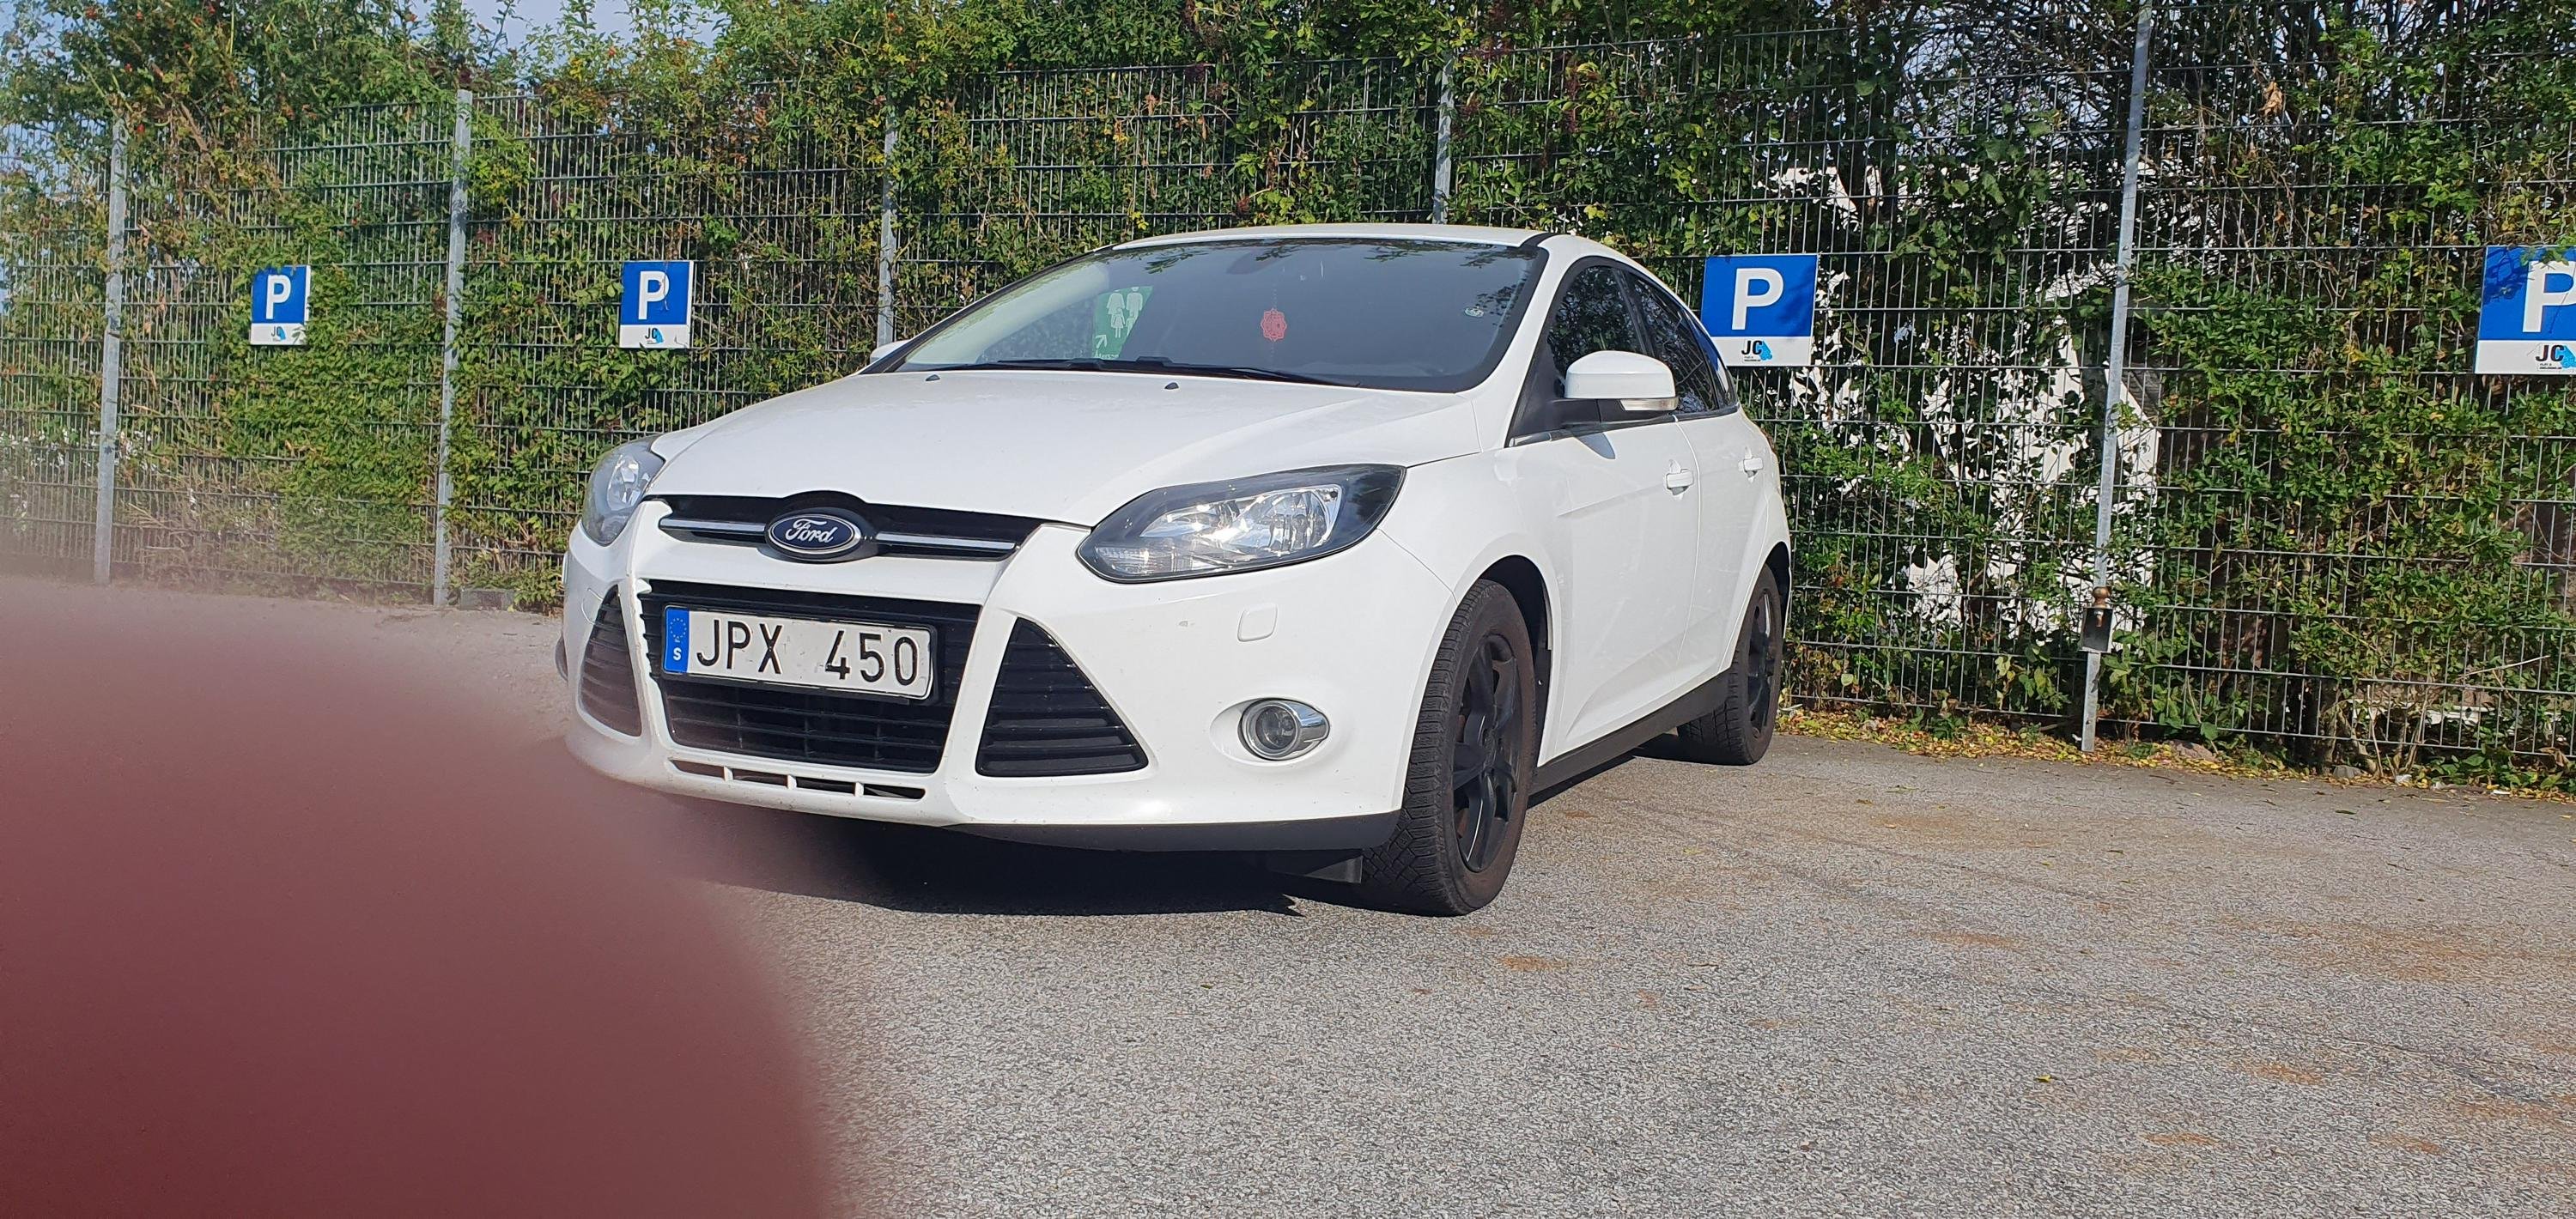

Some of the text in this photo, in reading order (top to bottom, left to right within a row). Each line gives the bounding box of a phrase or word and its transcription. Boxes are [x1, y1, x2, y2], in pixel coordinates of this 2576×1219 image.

[265, 274, 292, 320] P
[638, 270, 670, 320] P
[1731, 268, 1784, 331] P
[2522, 260, 2576, 333] P
[644, 327, 658, 339] JC
[1741, 340, 1763, 355] JC
[2535, 344, 2565, 361] JC
[785, 518, 838, 543] Ford
[672, 646, 683, 661] S
[696, 619, 920, 687] JPX 450
